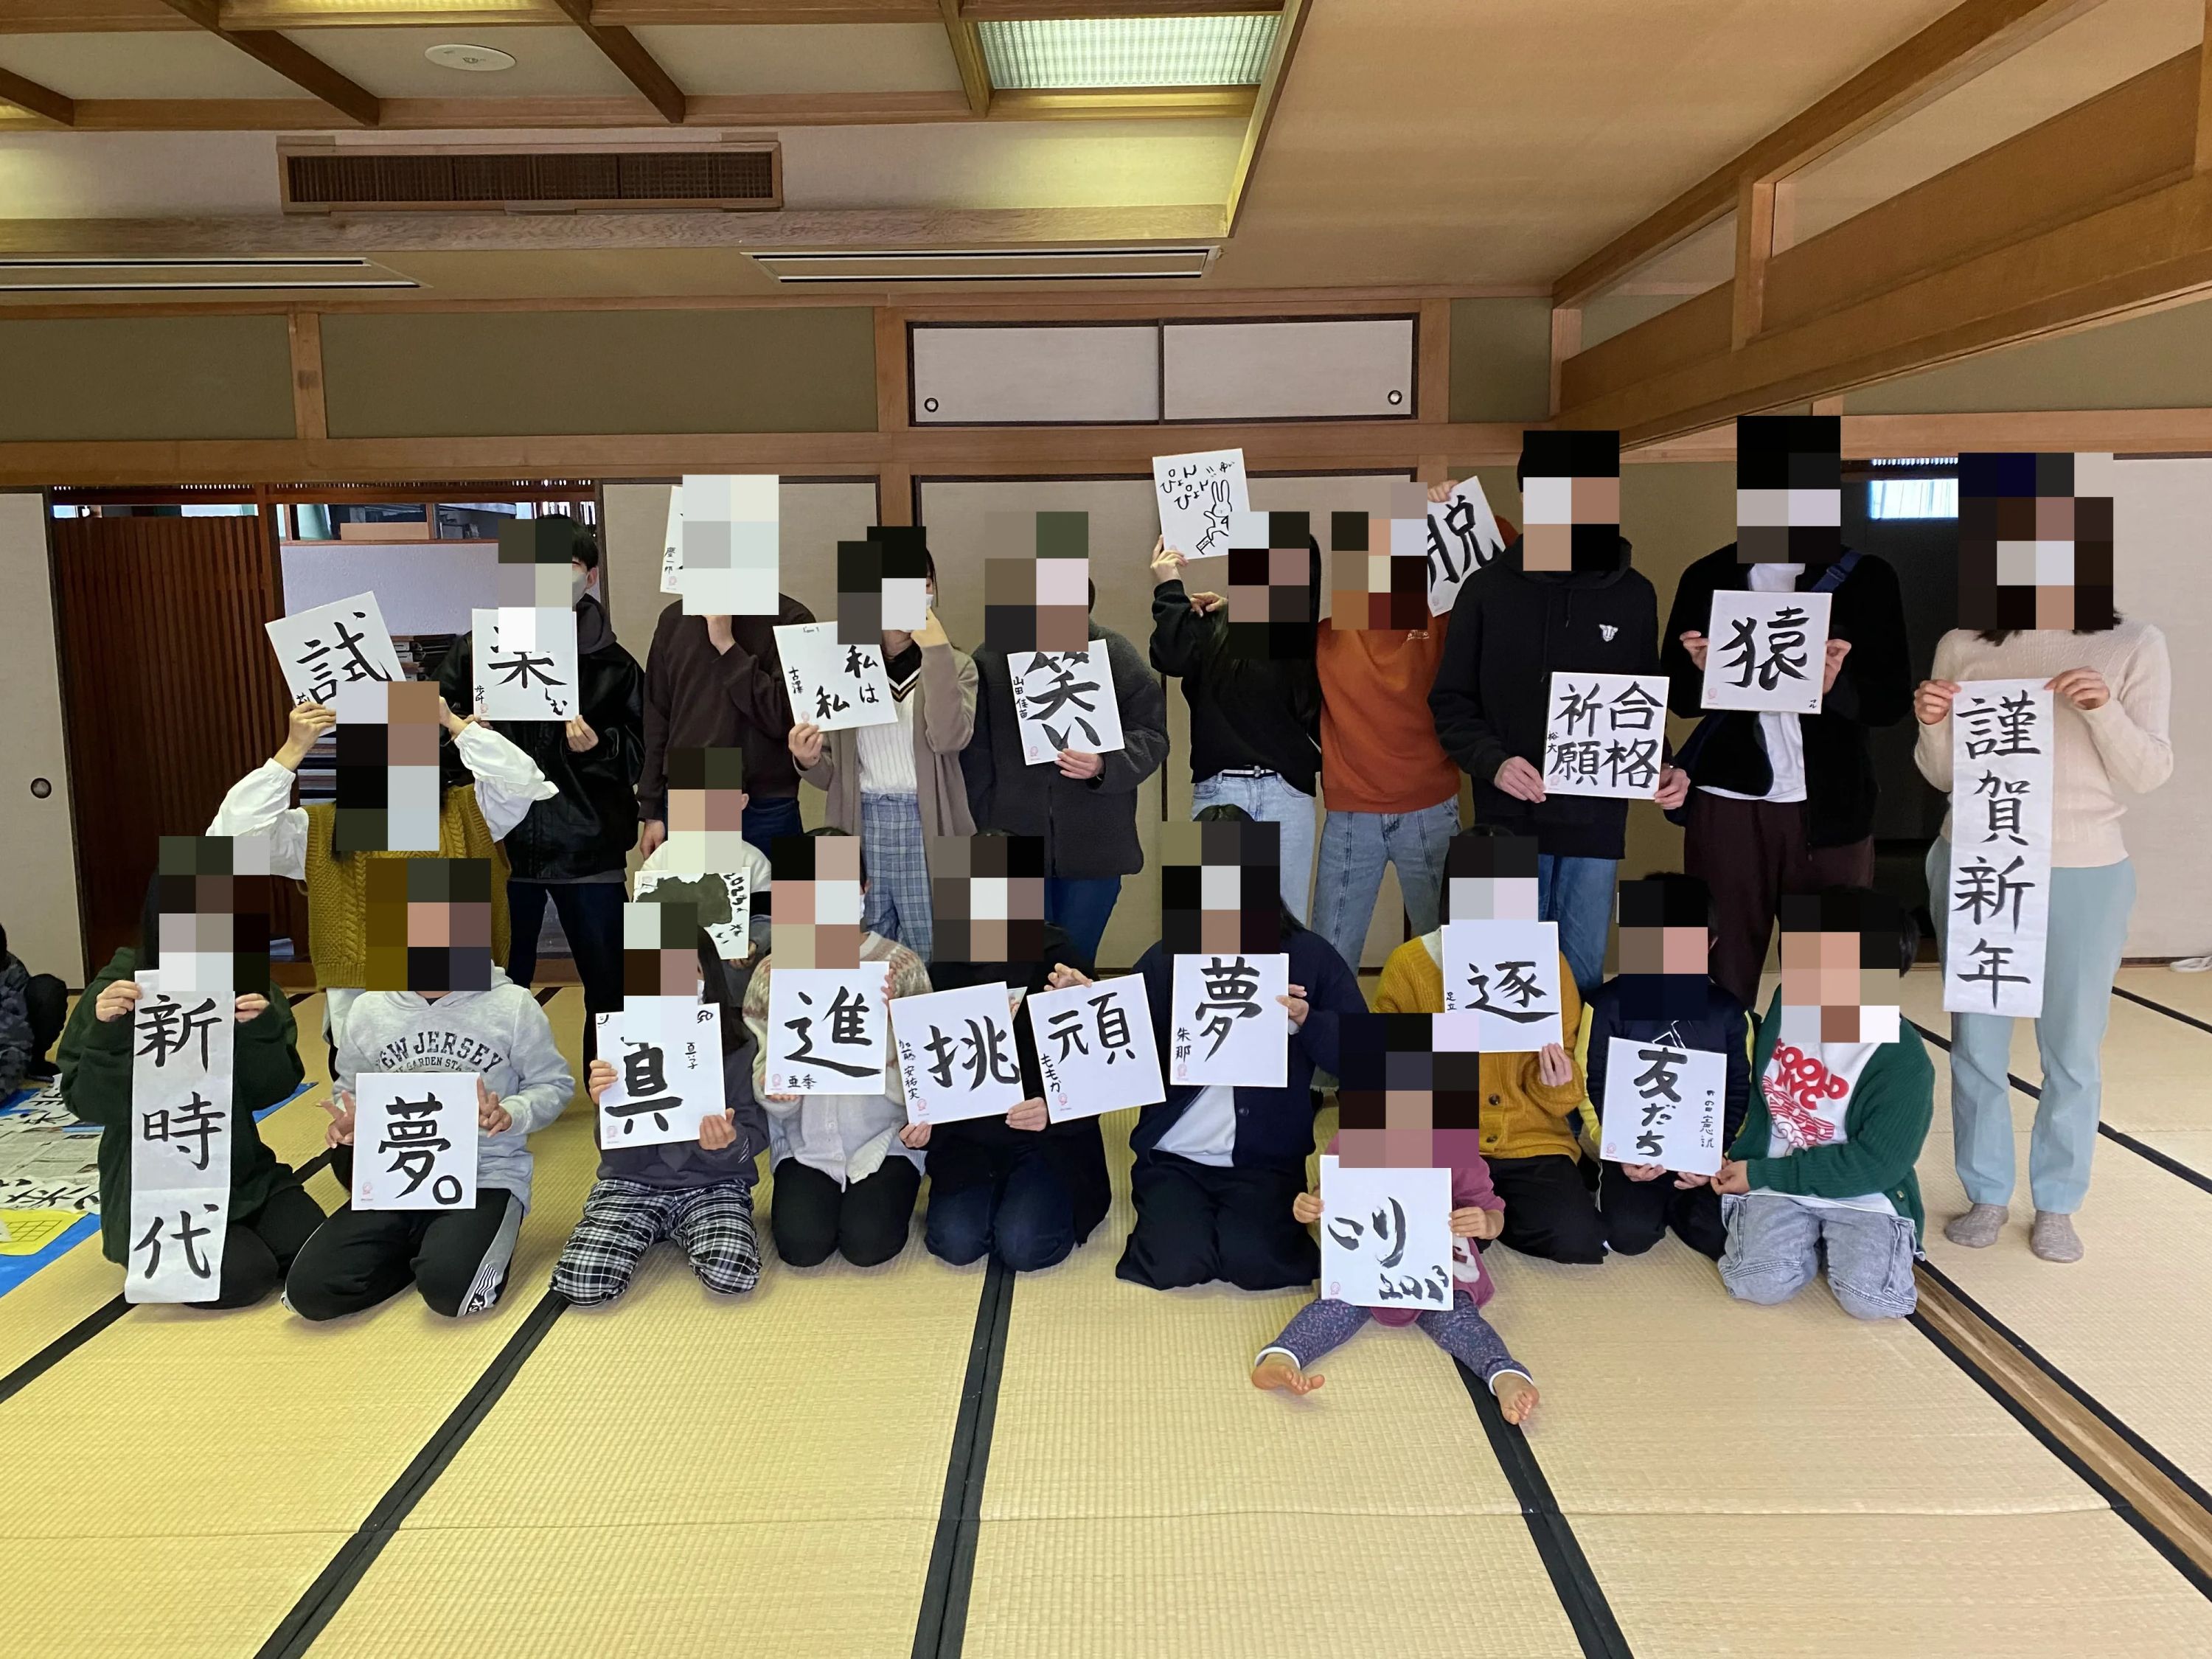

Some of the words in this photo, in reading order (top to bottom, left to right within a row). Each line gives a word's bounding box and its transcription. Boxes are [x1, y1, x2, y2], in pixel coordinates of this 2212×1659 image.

[844, 645, 880, 703] 私は
[1718, 606, 1810, 691] 猿
[816, 686, 850, 719] 私
[1548, 683, 1605, 787] 祈願
[1600, 681, 1664, 789] 合格
[1952, 689, 2041, 1009] 謹賀新年
[413, 1031, 504, 1074] JERSEY
[785, 986, 882, 1078] 進
[1048, 992, 1135, 1065] 頑
[1195, 956, 1262, 1062] 夢
[406, 1057, 442, 1071] GARDEN
[924, 1015, 1020, 1092] 挑
[133, 994, 226, 1279] 新時代
[1633, 1047, 1688, 1157] 友だち
